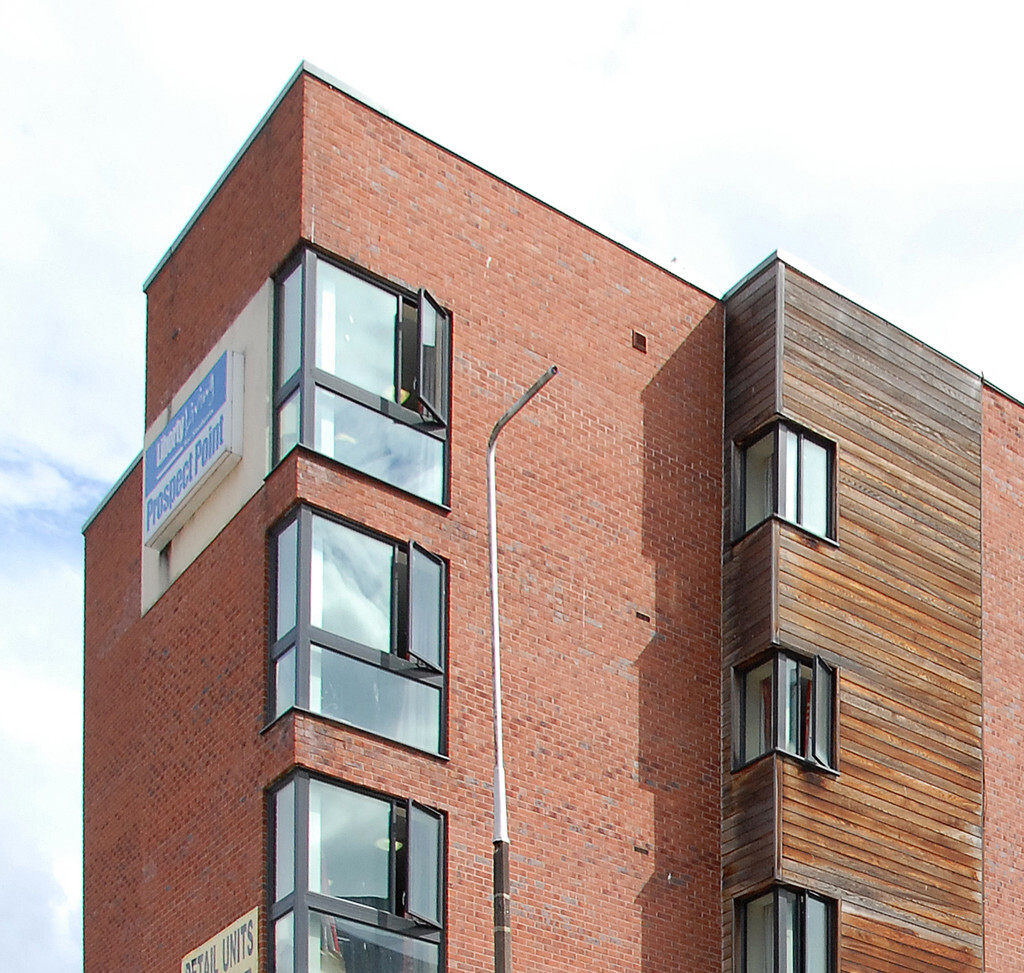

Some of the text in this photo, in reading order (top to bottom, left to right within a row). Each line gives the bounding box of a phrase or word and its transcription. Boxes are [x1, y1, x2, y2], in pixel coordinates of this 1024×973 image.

[146, 414, 225, 532] Prospect Point
[222, 919, 254, 972] UNITS
